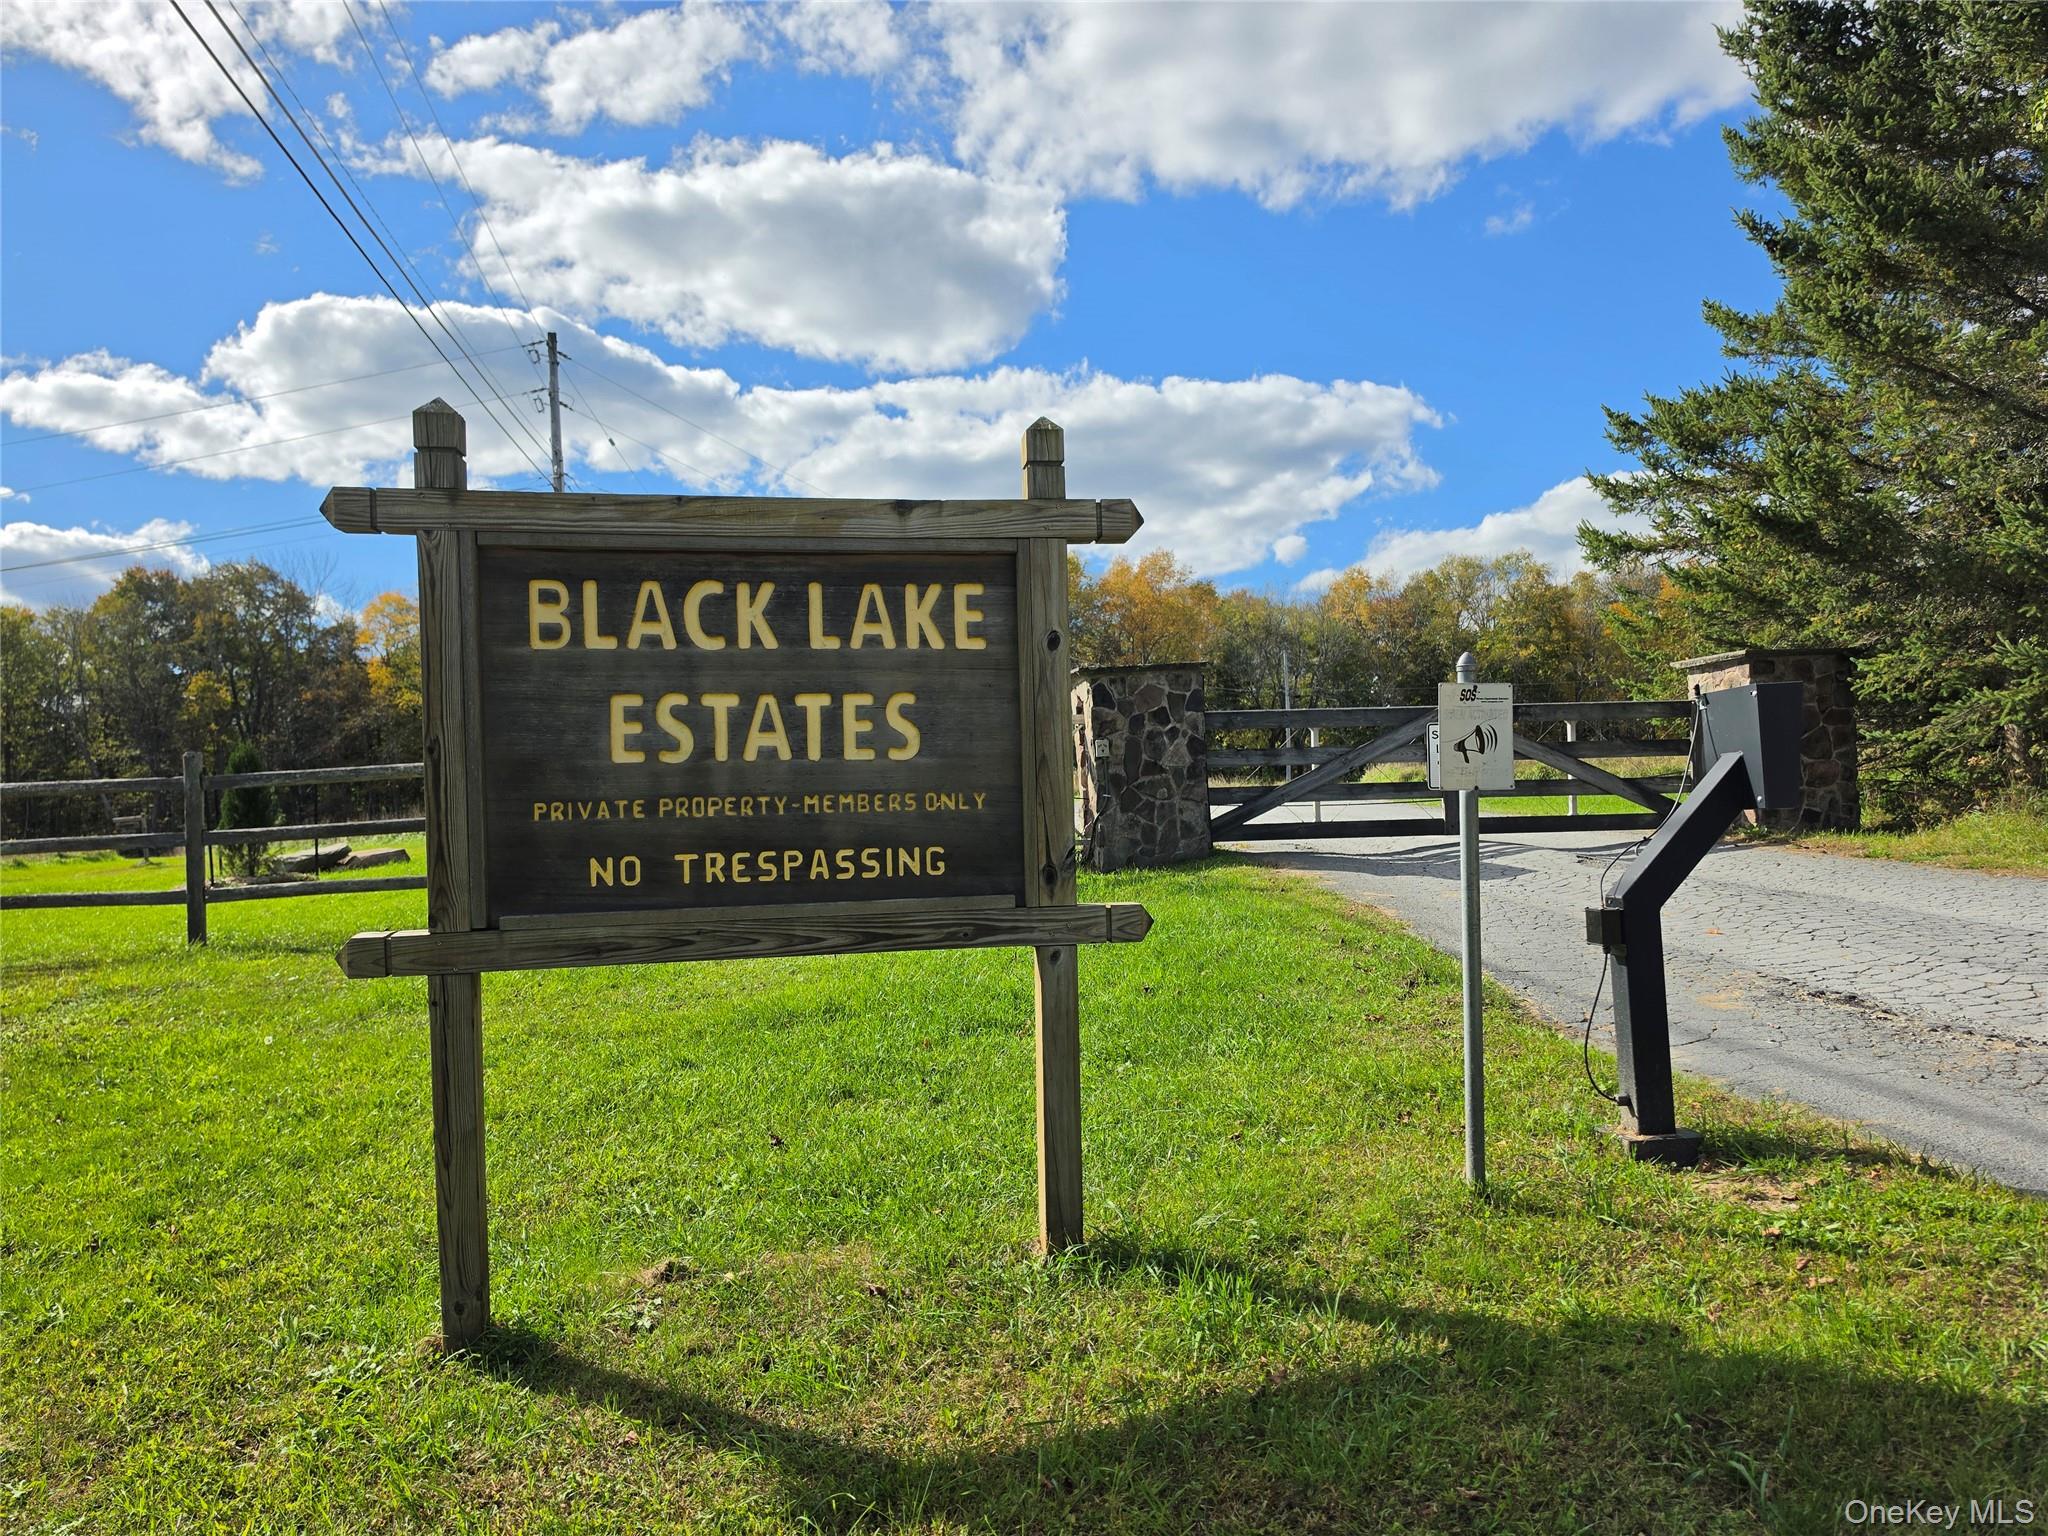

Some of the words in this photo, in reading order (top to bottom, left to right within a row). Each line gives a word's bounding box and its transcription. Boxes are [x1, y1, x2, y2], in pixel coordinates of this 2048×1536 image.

[528, 579, 780, 651] BLACK
[807, 581, 988, 651] LAKE
[608, 692, 922, 765] ESTATES
[533, 798, 646, 823] PRIVATE
[925, 792, 987, 812] ONLY
[589, 855, 642, 888] NO
[674, 846, 947, 884] TRESPASSING
